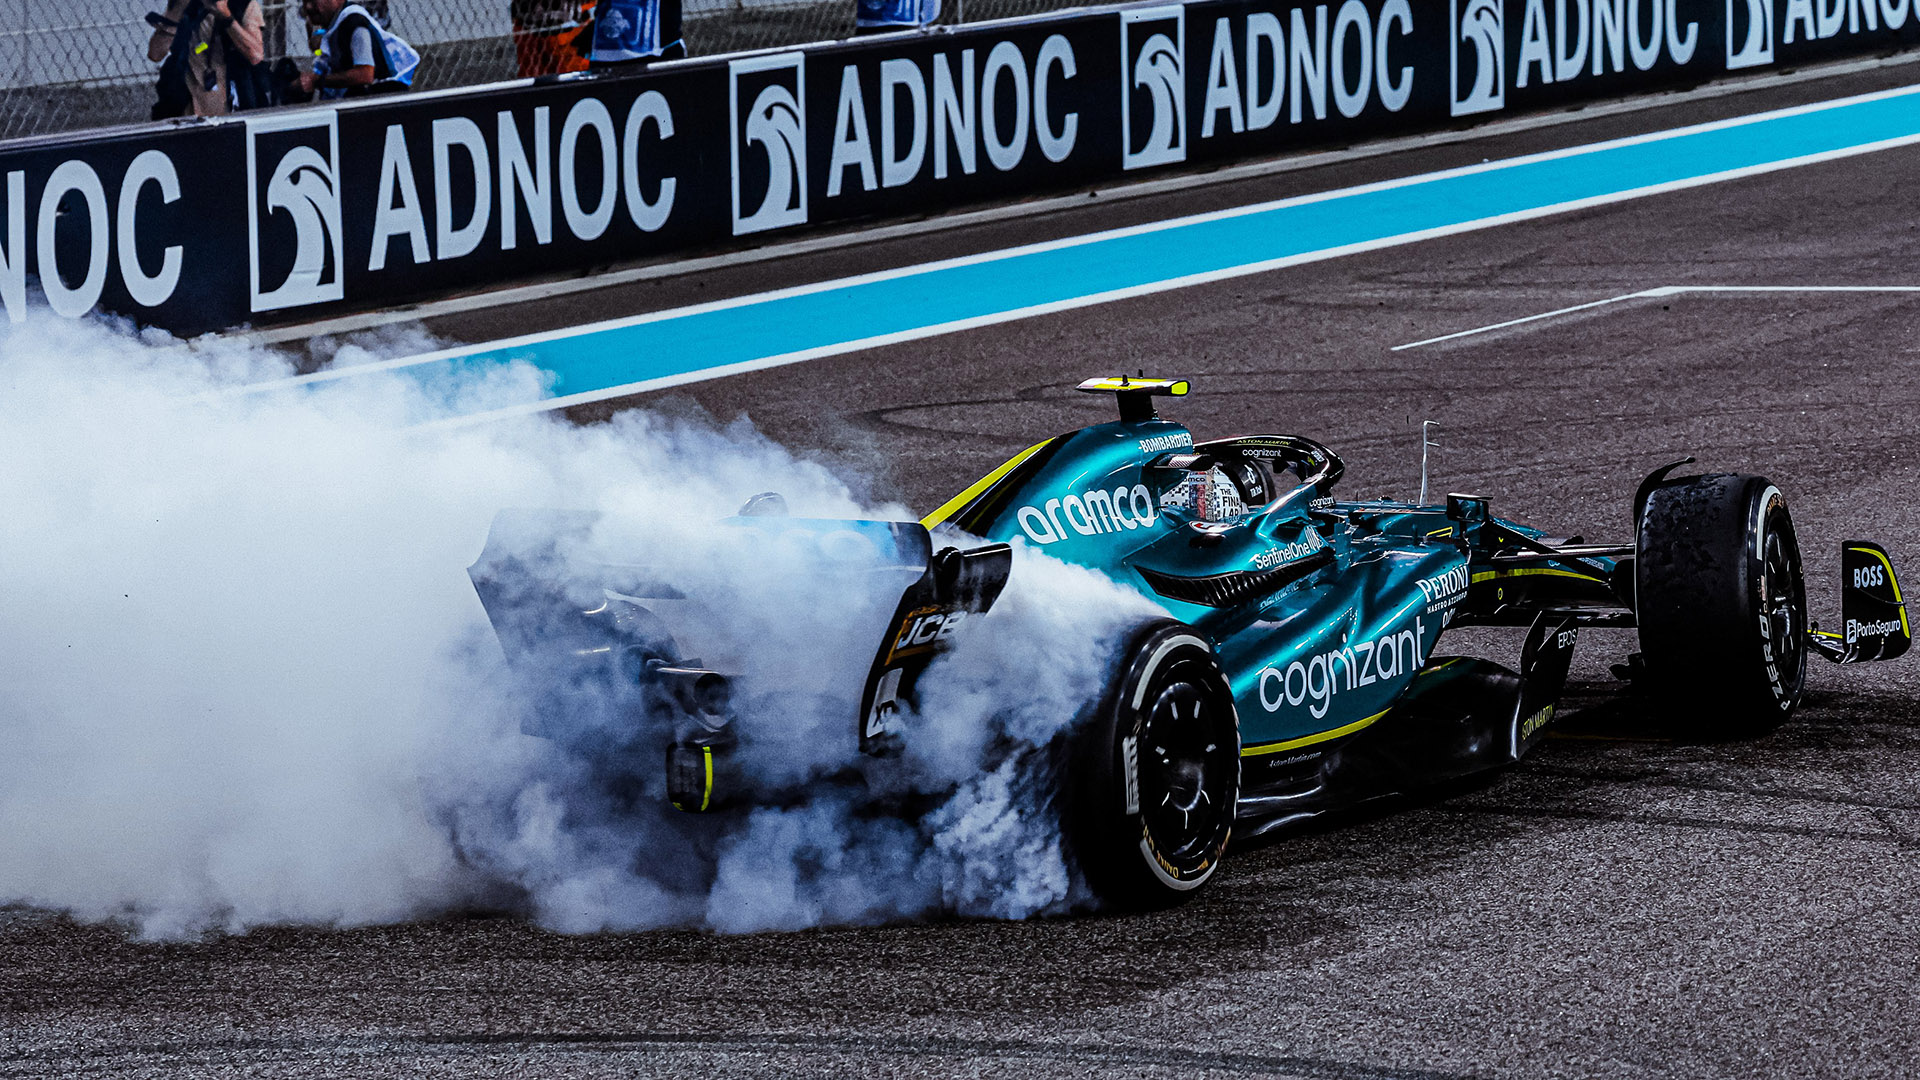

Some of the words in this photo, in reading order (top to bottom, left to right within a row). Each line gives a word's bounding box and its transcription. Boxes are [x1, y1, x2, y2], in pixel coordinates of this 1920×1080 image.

[1202, 0, 1414, 138] ADNOC
[1516, 0, 1699, 88] ADNOC
[827, 34, 1078, 198] ADNOC
[368, 90, 677, 271] ADNOC
[1140, 432, 1193, 454] BOMBARDIER
[1242, 448, 1282, 458] cognizant
[1017, 484, 1154, 545] aramco
[1255, 541, 1311, 570] SentinelOne
[1853, 564, 1884, 589] BOSS
[1415, 564, 1469, 604] PERONI
[1426, 600, 1448, 615] NASTRO
[896, 611, 969, 650] JCB
[1258, 616, 1426, 719] cognizant
[1759, 614, 1784, 700] ZERO
